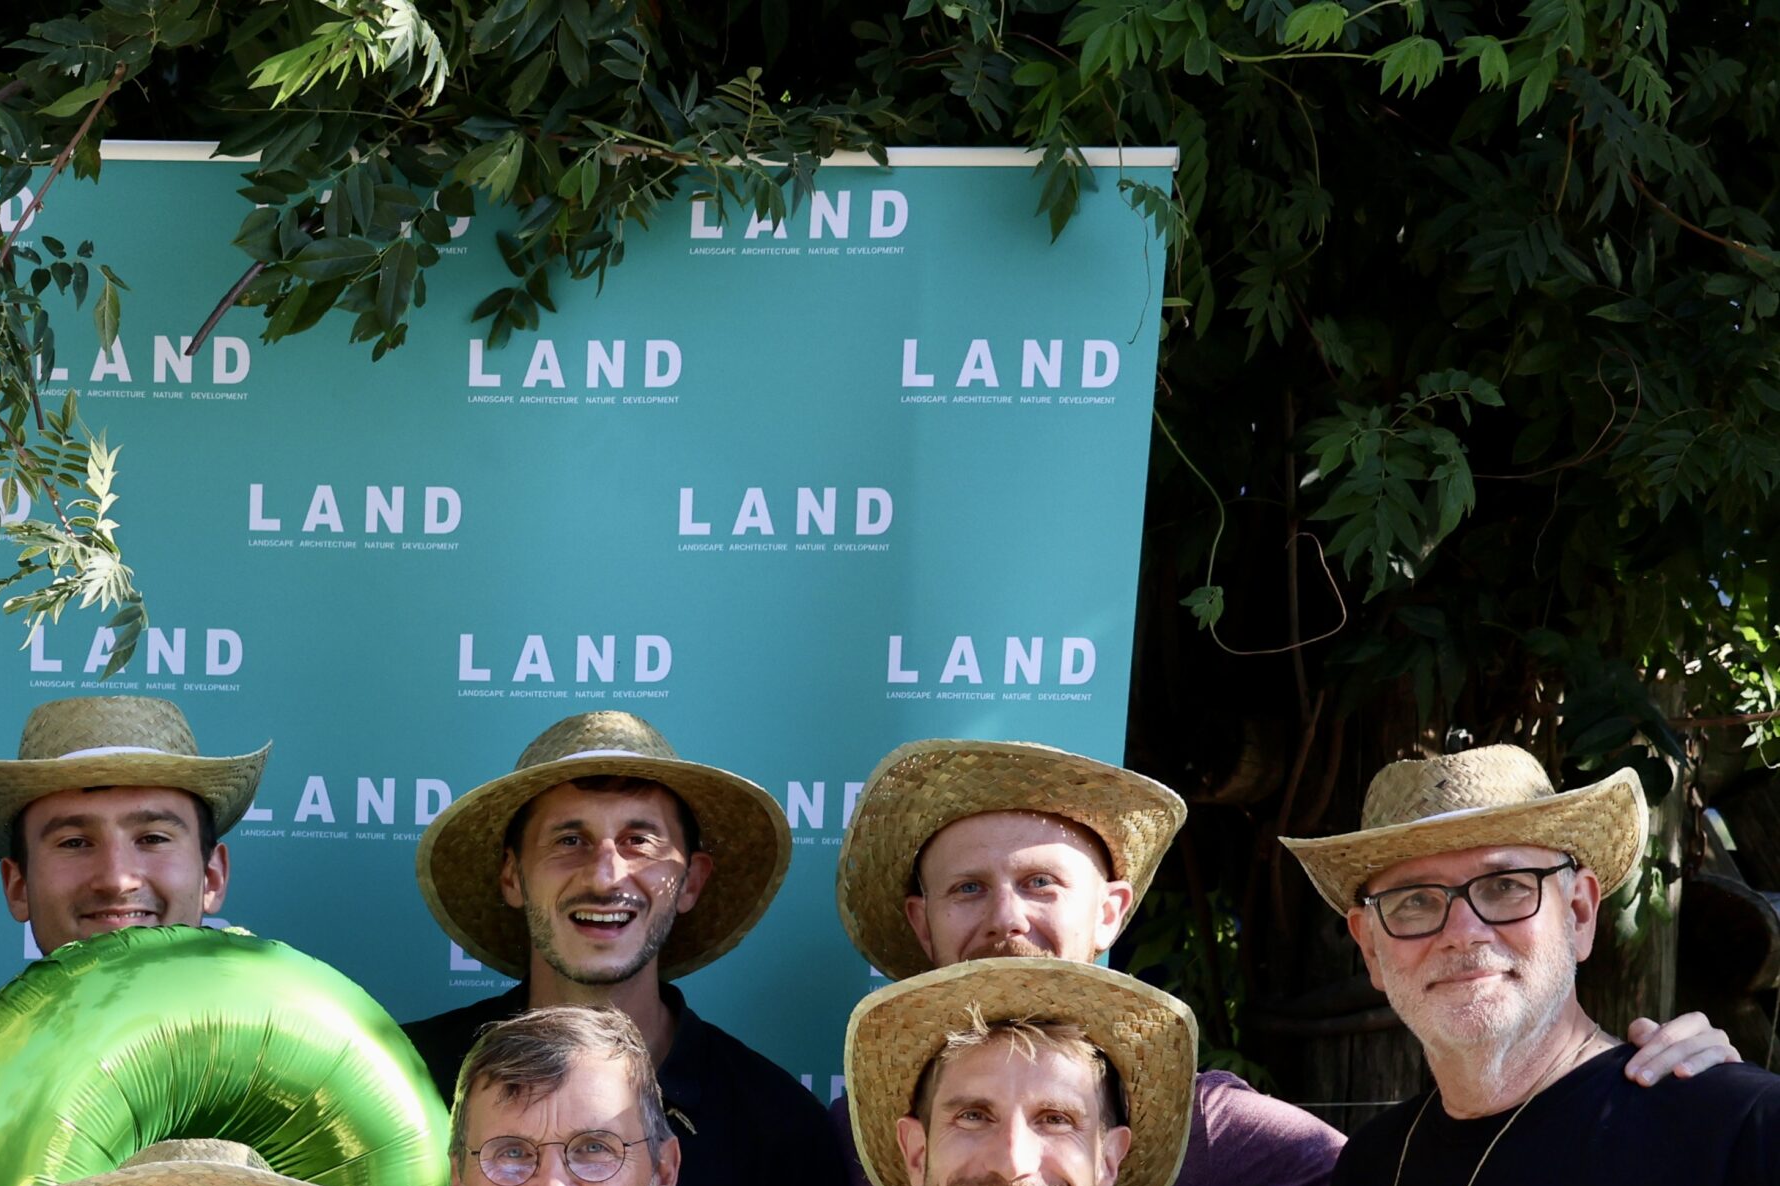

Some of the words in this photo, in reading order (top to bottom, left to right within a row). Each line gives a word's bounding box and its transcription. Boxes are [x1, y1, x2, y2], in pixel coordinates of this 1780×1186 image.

[690, 190, 909, 239] LAND
[469, 340, 681, 388] LAND
[903, 339, 1119, 388] LAND
[87, 390, 145, 398] ARCHITECTURE
[191, 392, 247, 400] DEVELOPMENT
[250, 484, 461, 533] LAND
[679, 488, 892, 535] LAND
[300, 540, 356, 548] ARCHITECTURE
[30, 624, 243, 676] LAND
[459, 634, 671, 682] LAND
[888, 636, 1095, 684] LAND
[81, 681, 138, 689] ARCHITECTURE
[184, 683, 239, 691] DEVELOPMENT
[937, 692, 995, 700] ARCHITECTURE
[291, 831, 347, 839] ARCHITECTURE
